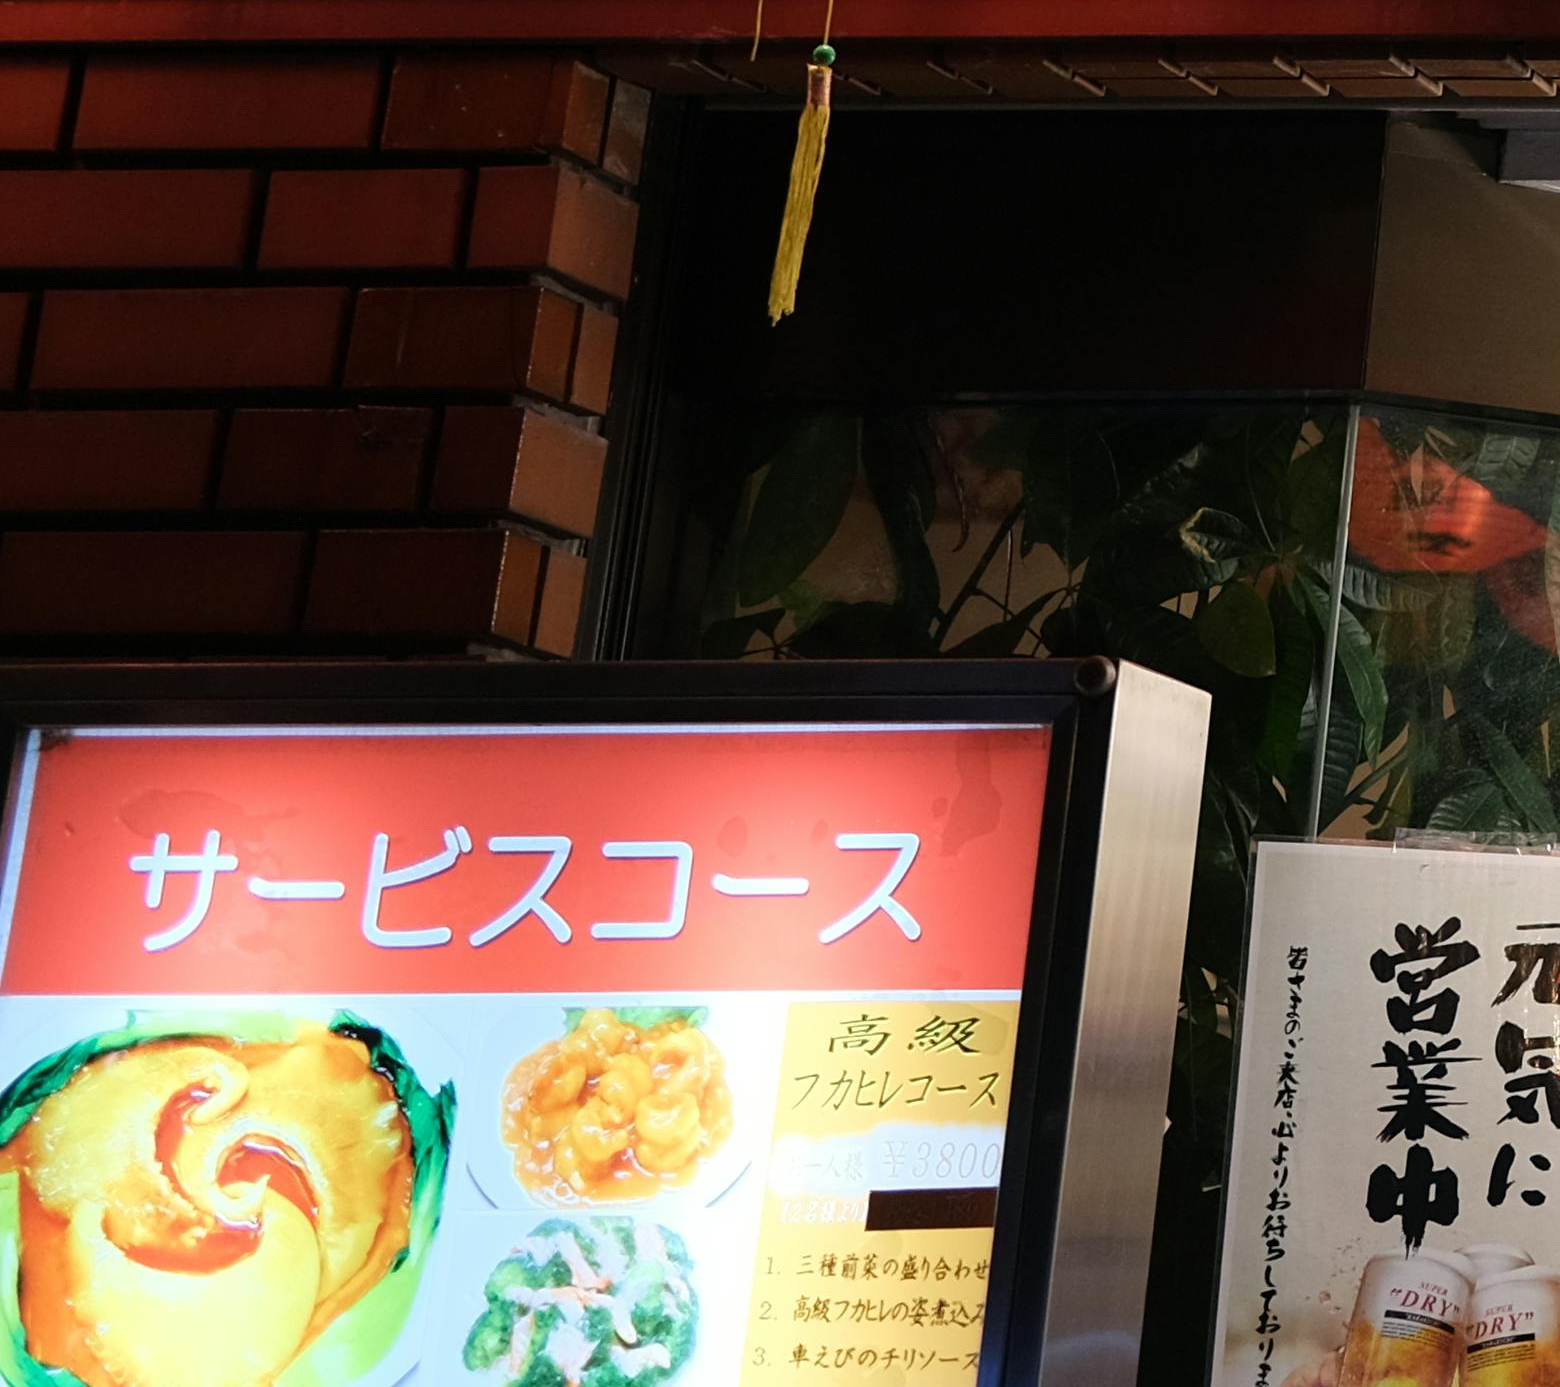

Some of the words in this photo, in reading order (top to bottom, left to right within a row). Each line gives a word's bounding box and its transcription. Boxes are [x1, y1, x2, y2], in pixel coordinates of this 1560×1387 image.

[129, 825, 922, 953] サービスコース
[828, 1013, 981, 1056] 高級
[791, 1069, 999, 1111] フカヒレコース
[1365, 916, 1483, 1259] 営業中
[1419, 1281, 1449, 1296] SUPER
[1485, 1304, 1513, 1316] SUPER
